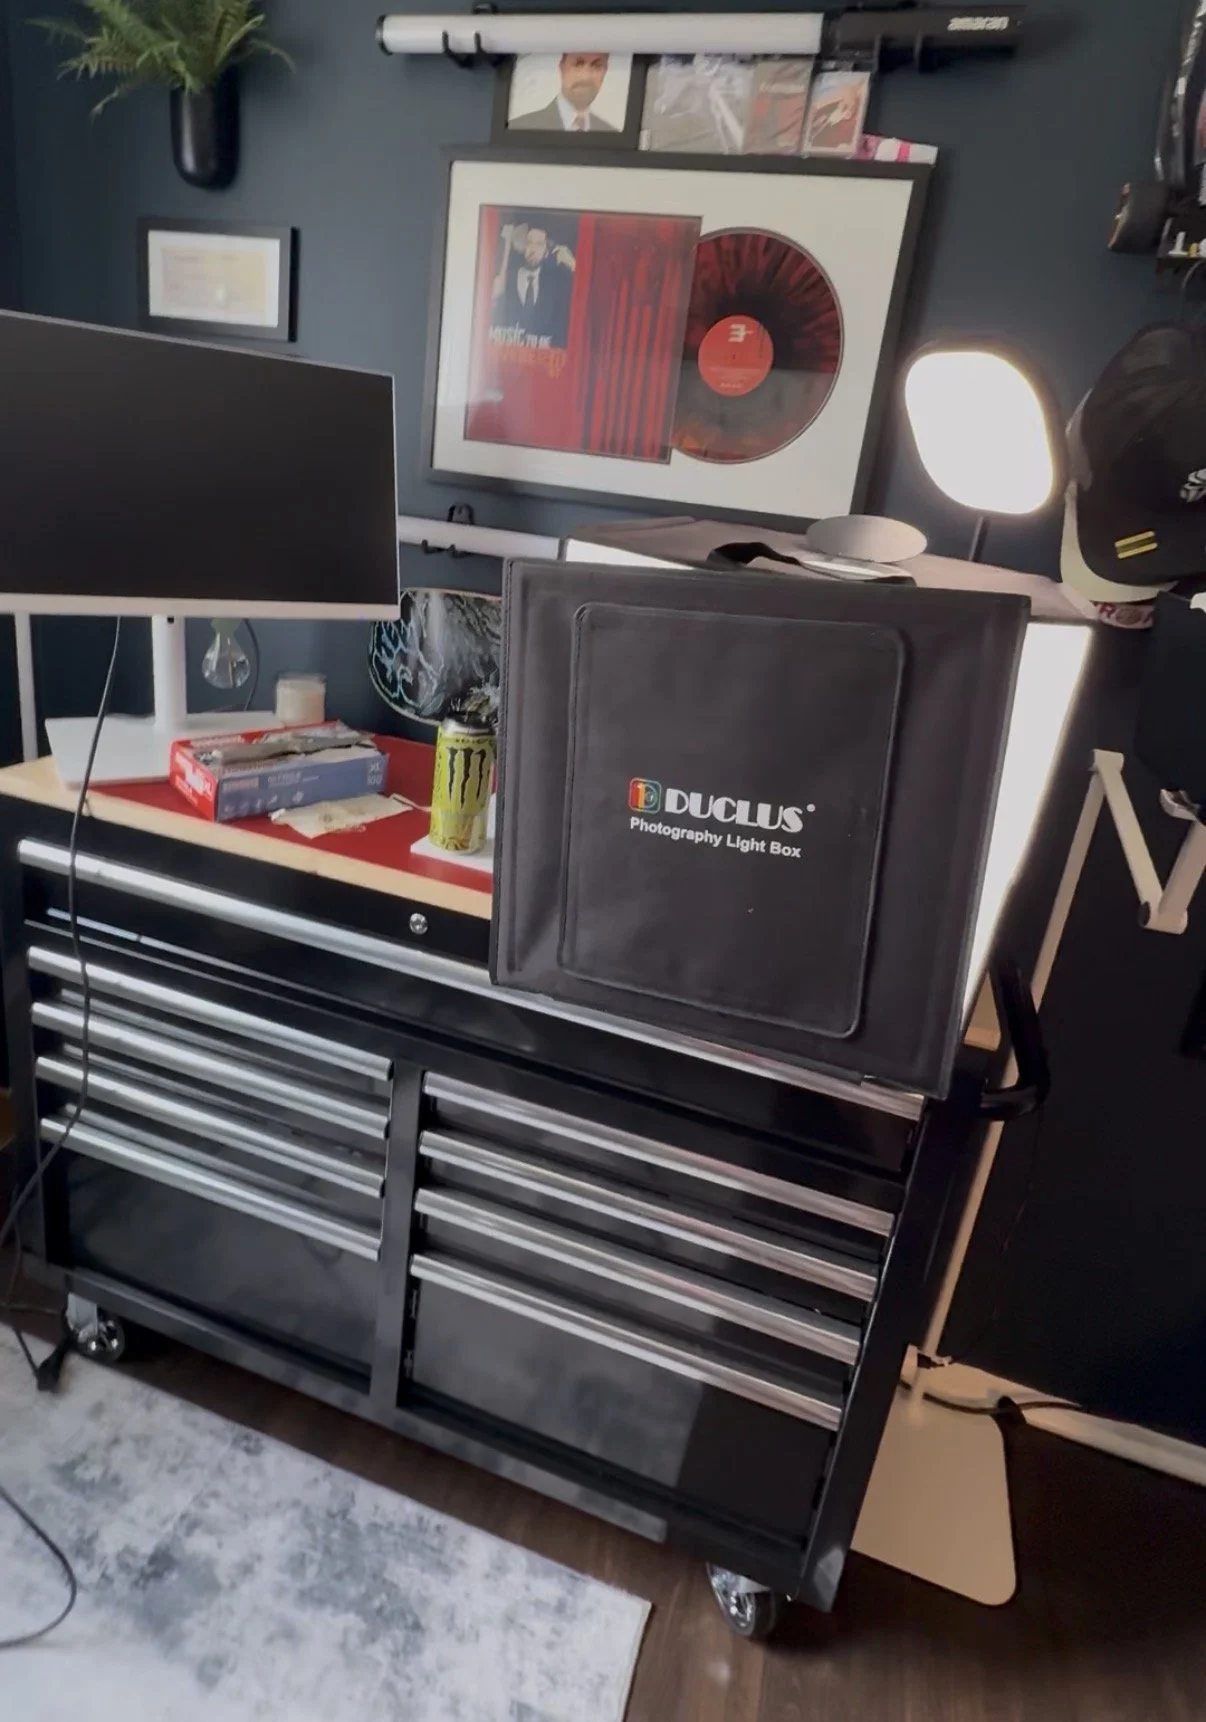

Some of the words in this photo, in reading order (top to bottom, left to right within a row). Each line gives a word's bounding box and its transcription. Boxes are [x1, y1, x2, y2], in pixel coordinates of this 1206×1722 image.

[664, 788, 804, 833] DUCLUS
[630, 816, 723, 848] Photography
[726, 834, 766, 853] Light
[770, 841, 801, 858] Box
